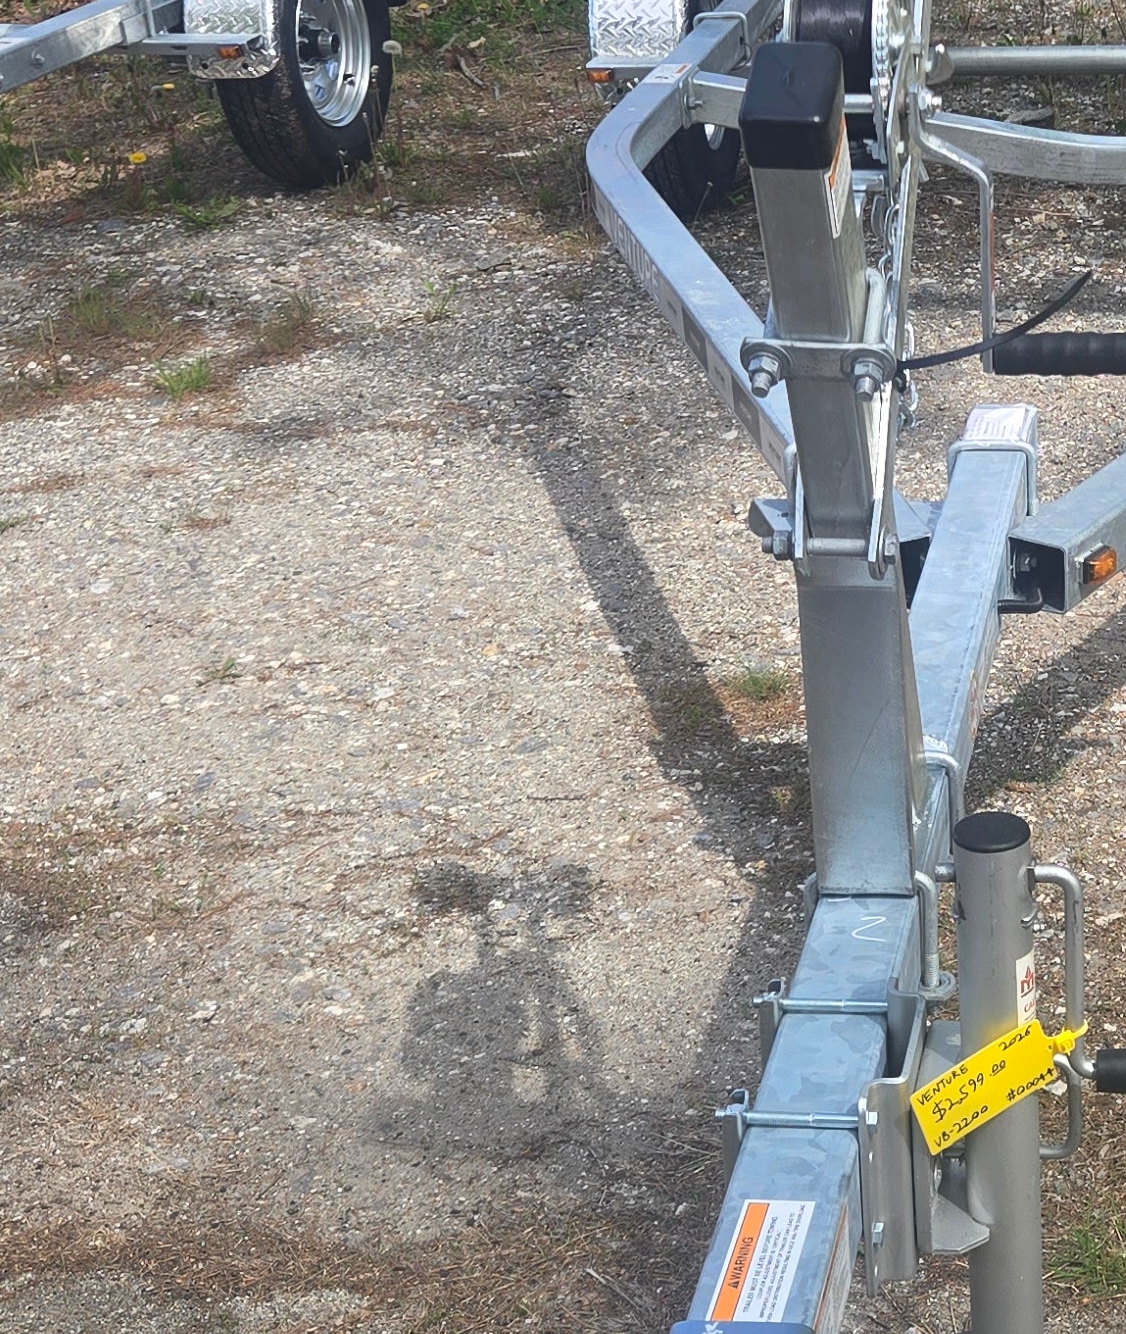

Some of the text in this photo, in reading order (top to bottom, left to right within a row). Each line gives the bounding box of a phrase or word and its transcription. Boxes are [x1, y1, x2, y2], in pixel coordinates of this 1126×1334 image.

[917, 1025, 1032, 1106] VENTURE 2026
[934, 1105, 989, 1147] VB-2200
[731, 1237, 753, 1278] WARNING
